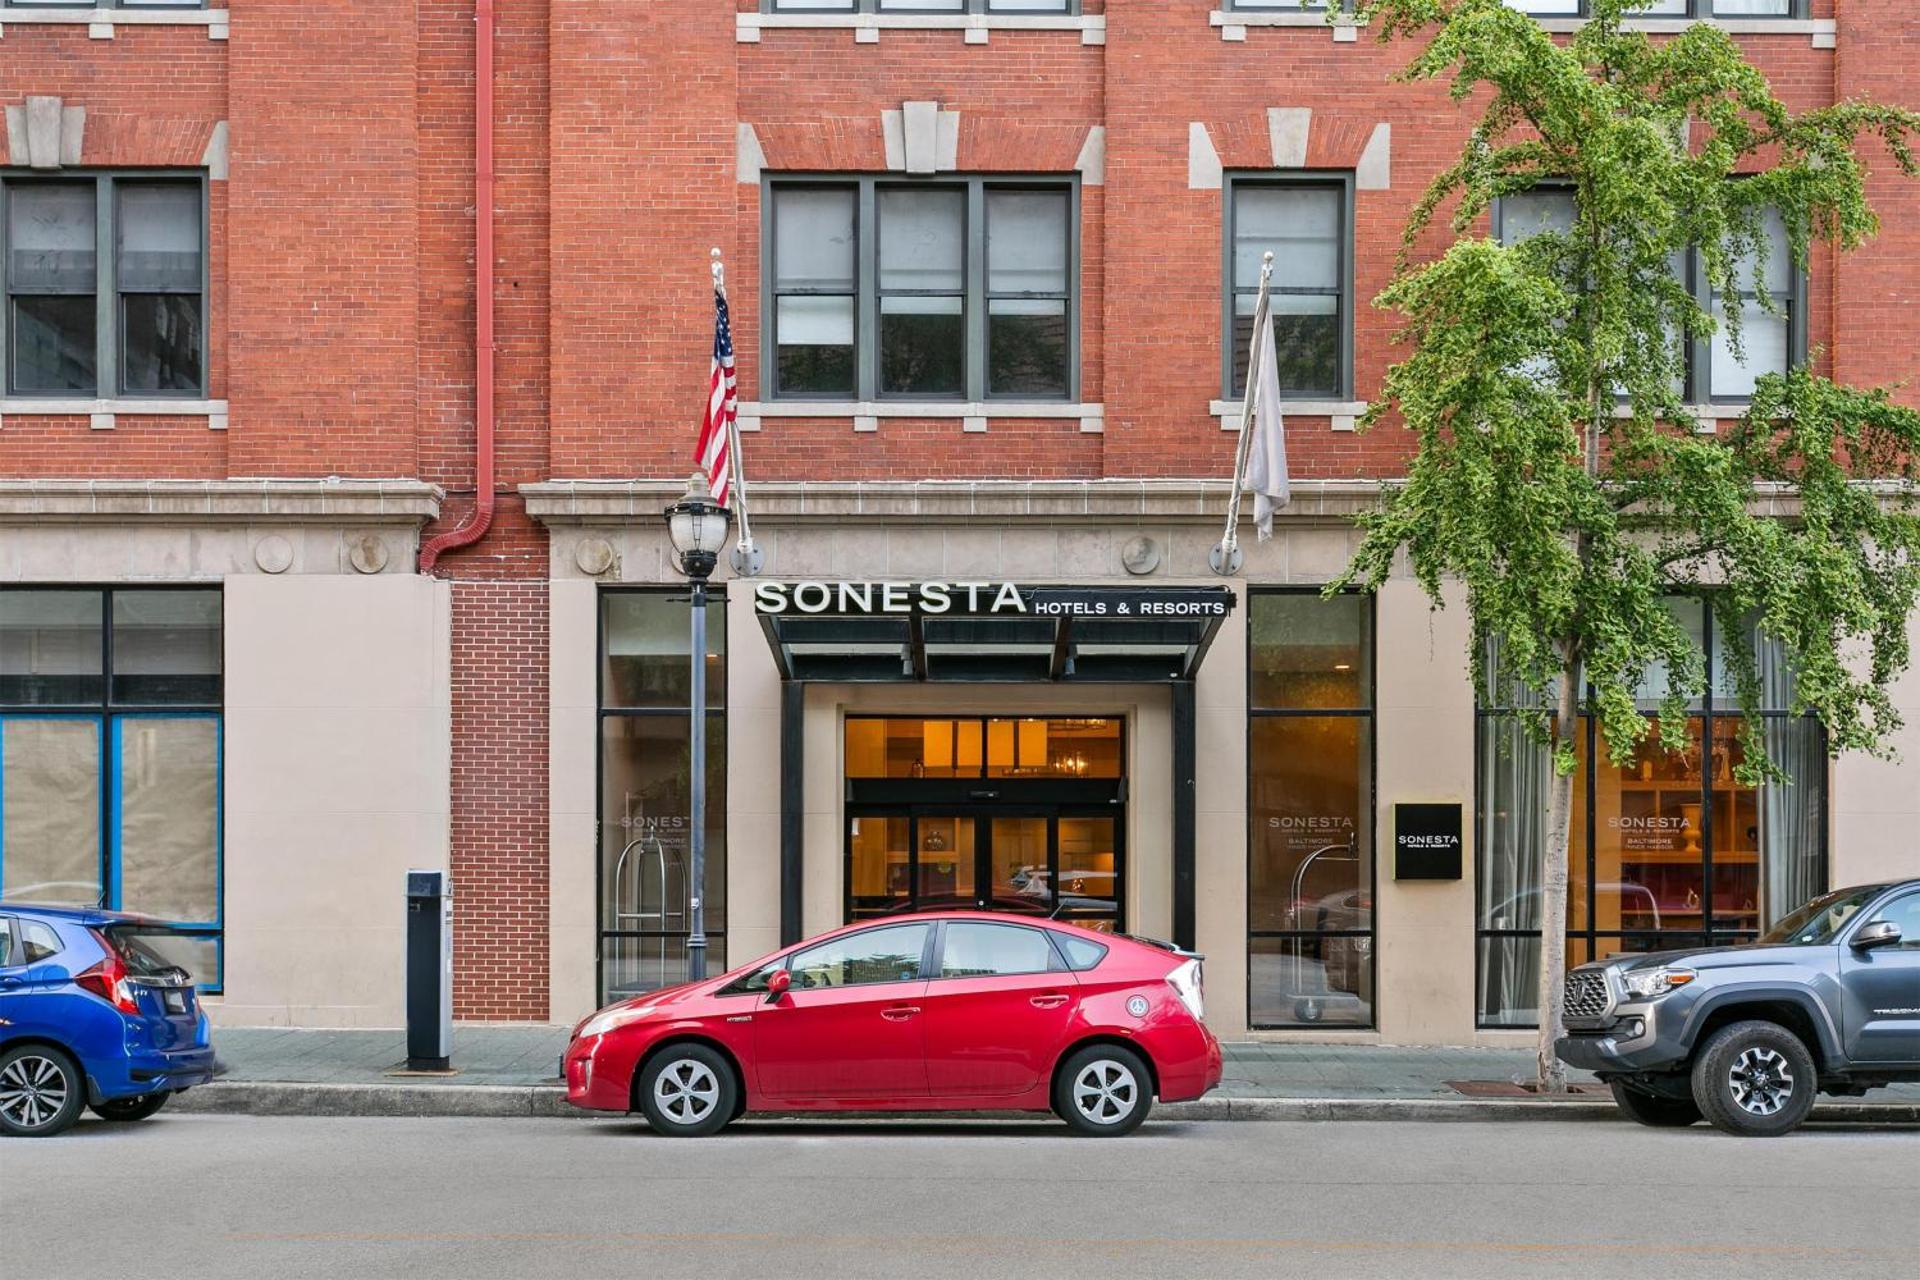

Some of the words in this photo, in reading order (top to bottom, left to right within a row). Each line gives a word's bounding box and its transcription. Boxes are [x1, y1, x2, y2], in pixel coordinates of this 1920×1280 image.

[755, 582, 1027, 613] SONESTA
[1035, 602, 1107, 614] HOTELS
[1117, 602, 1130, 614] &
[1140, 602, 1225, 614] RESORTS
[621, 816, 691, 828] SONES
[1269, 817, 1353, 828] SONESTA
[1608, 817, 1691, 828] SONESTA
[1398, 835, 1459, 844] SONESTA
